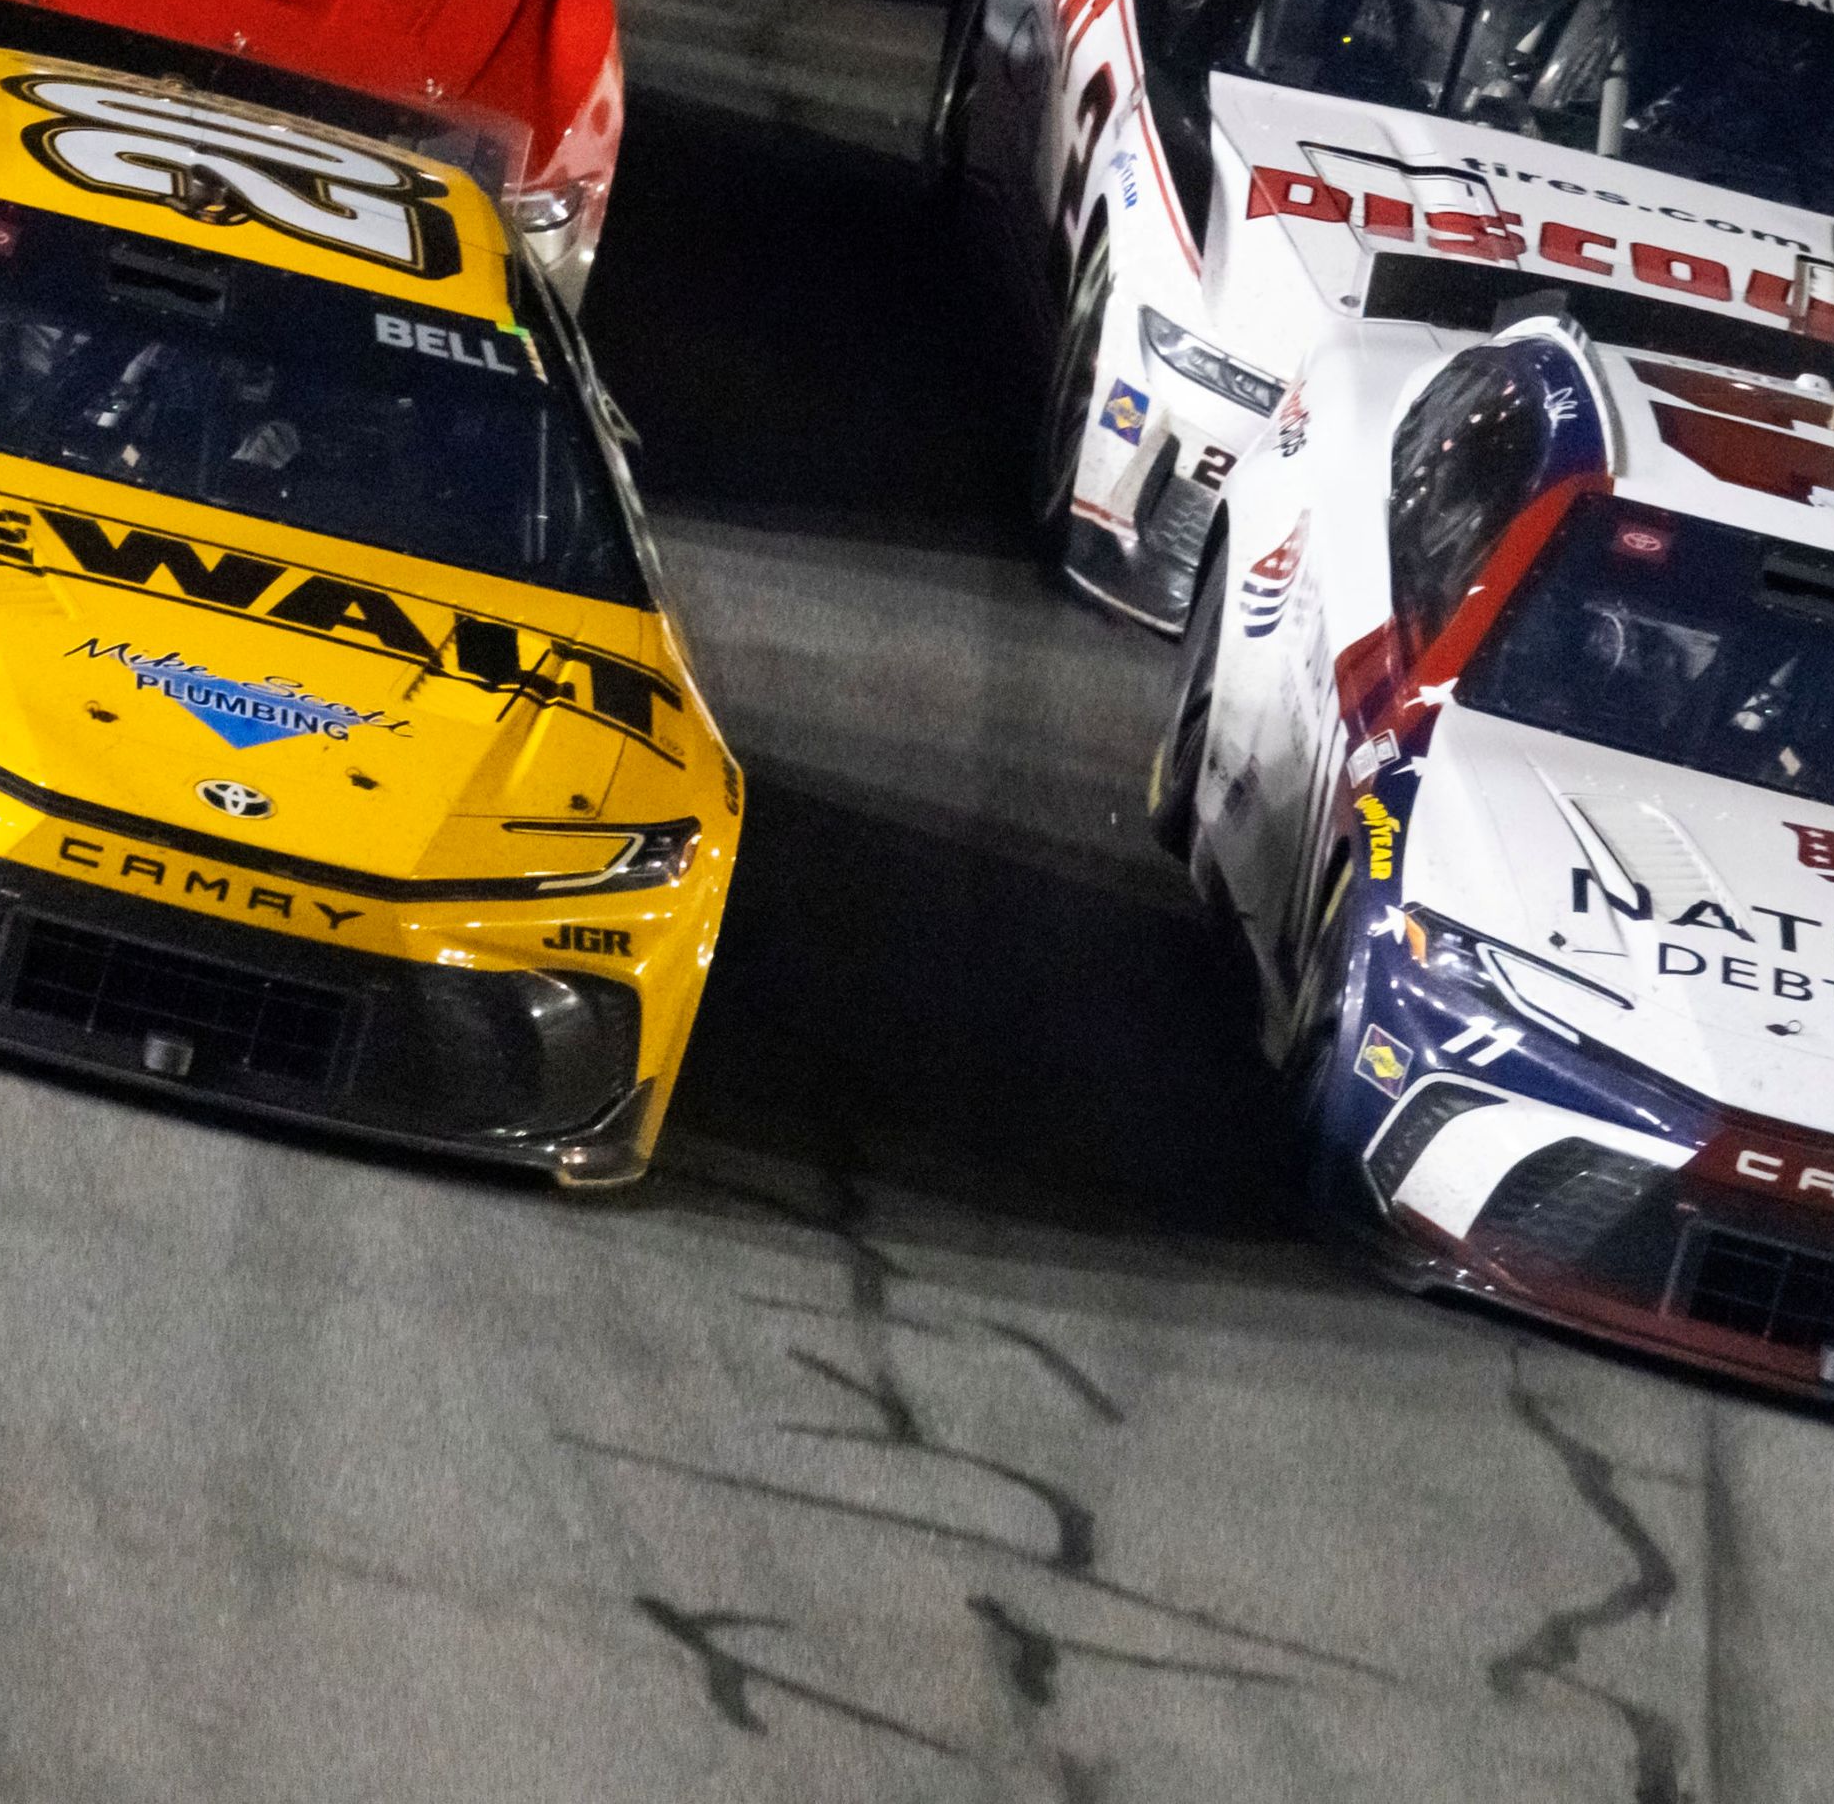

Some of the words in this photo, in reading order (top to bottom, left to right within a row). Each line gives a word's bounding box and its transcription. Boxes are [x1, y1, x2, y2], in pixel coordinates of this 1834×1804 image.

[12, 76, 447, 274] 20
[1461, 156, 1812, 254] tires.com
[374, 312, 519, 376] BELL
[1192, 446, 1238, 492] 2
[63, 637, 217, 680] Mike
[242, 676, 413, 739] Scott
[135, 673, 350, 742] PLUMBING
[60, 834, 365, 931] CAMRY
[542, 923, 633, 958] JGR
[1441, 1015, 1526, 1067] 11
